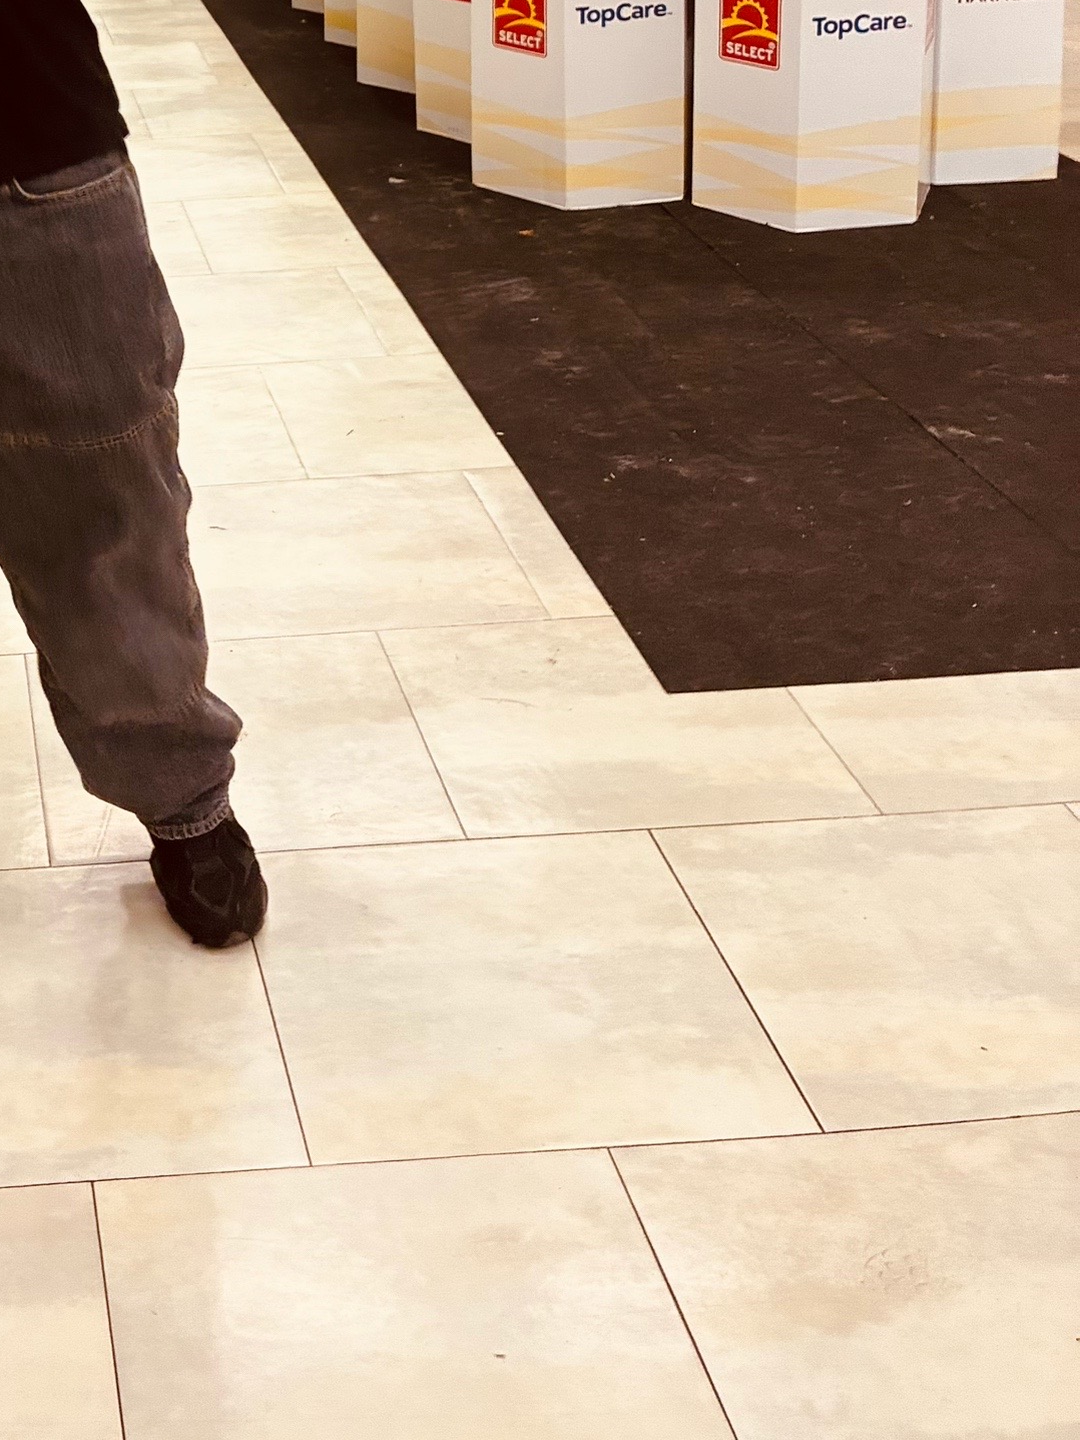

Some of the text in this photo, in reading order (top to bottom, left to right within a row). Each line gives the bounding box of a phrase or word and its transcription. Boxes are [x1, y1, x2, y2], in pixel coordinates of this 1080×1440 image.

[575, 2, 668, 27] TopCare
[812, 14, 907, 40] TopCare
[498, 30, 542, 50] SELECT
[726, 40, 774, 62] SELECT
